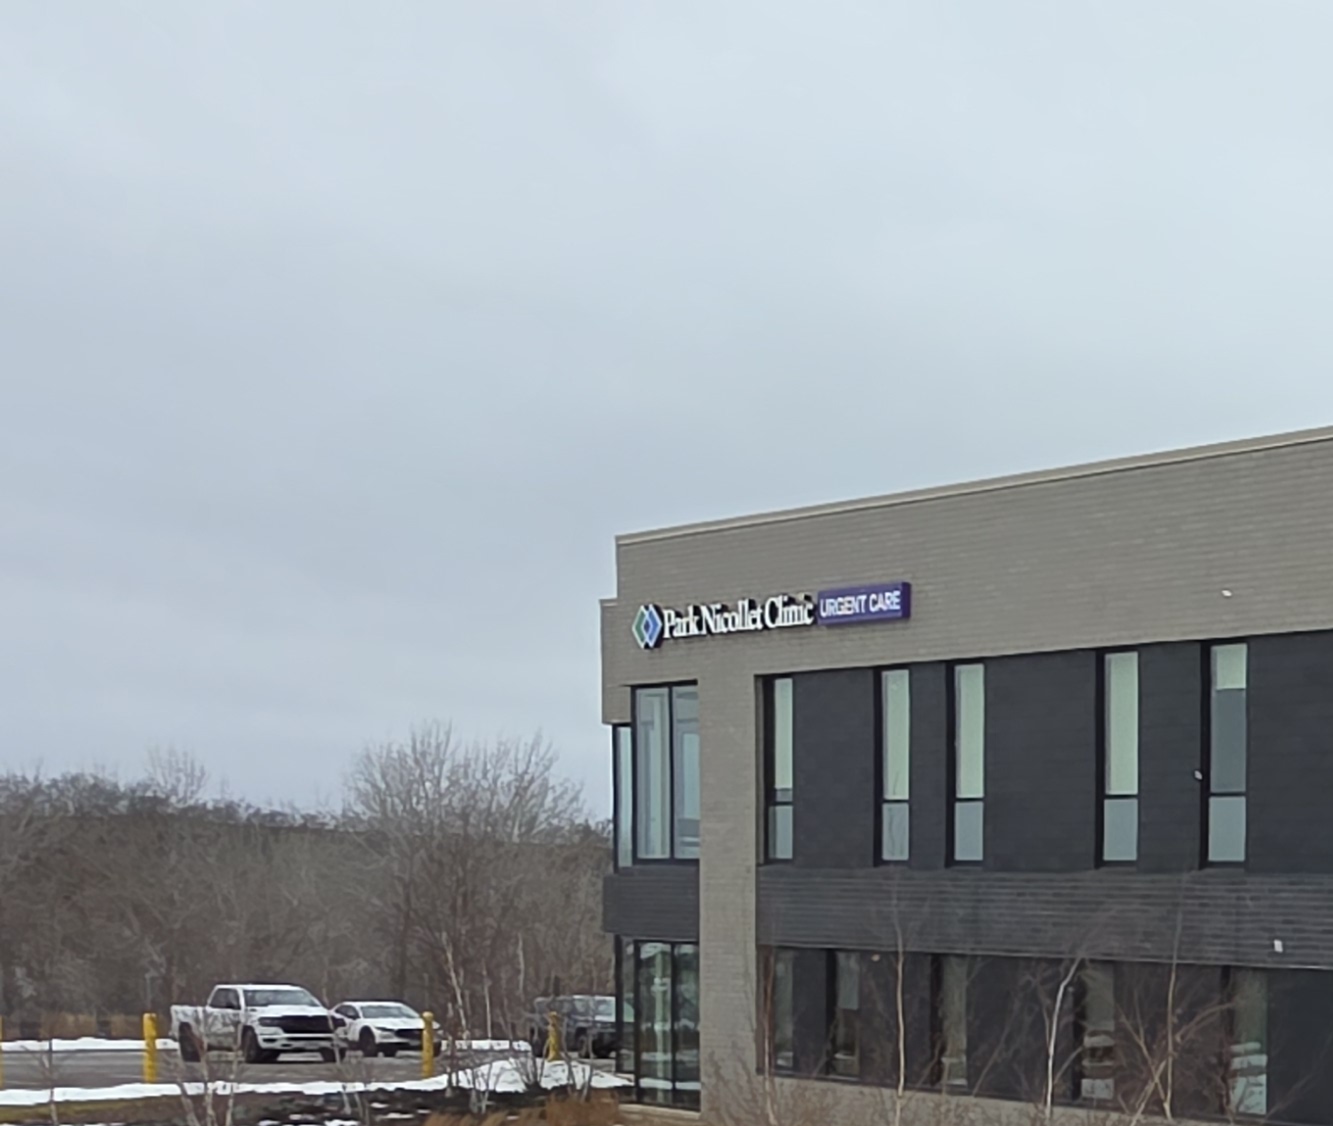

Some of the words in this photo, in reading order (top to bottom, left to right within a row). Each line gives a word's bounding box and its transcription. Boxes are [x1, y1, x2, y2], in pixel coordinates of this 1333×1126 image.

[662, 606, 699, 638] Park
[700, 598, 763, 635] Nicollet
[764, 594, 814, 628] Clinic
[820, 594, 866, 618] URGENT
[869, 590, 901, 612] CARE
